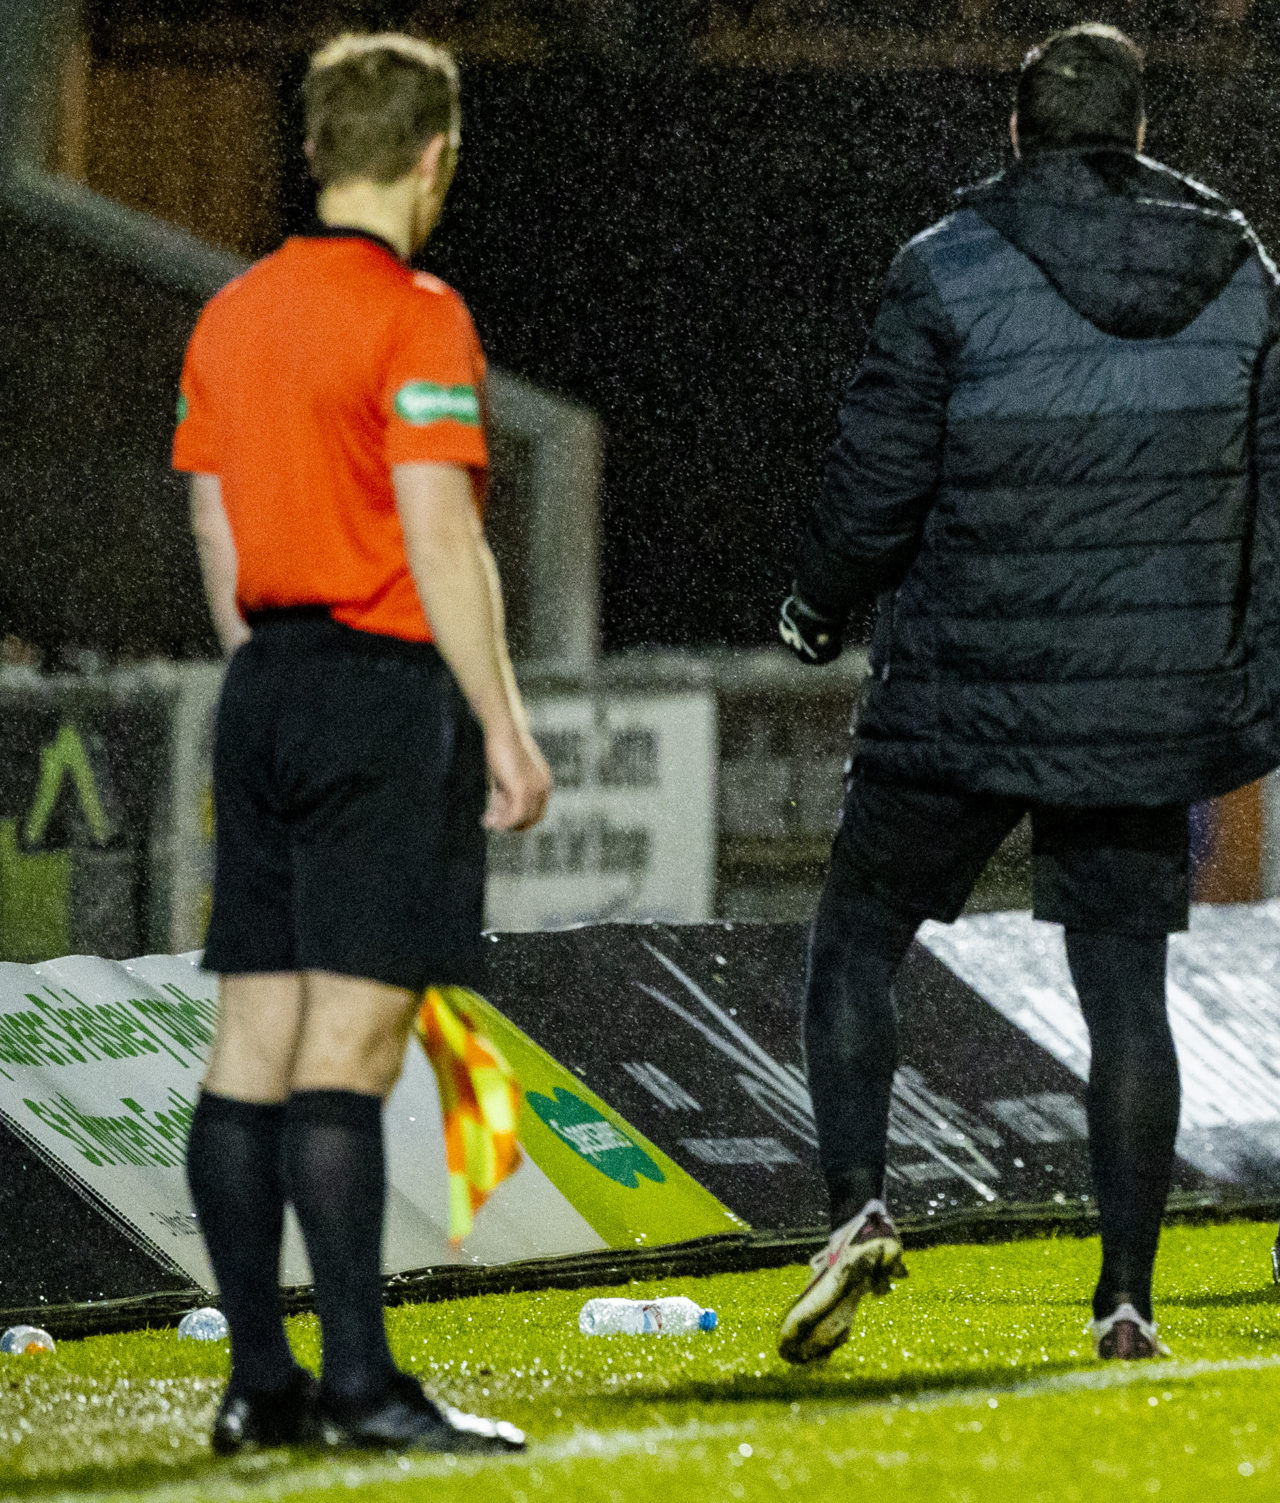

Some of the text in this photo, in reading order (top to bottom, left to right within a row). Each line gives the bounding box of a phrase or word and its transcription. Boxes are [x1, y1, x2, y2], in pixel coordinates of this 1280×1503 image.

[24, 984, 190, 1069] Paisley
[23, 1086, 198, 1168] St Mirren Foot
